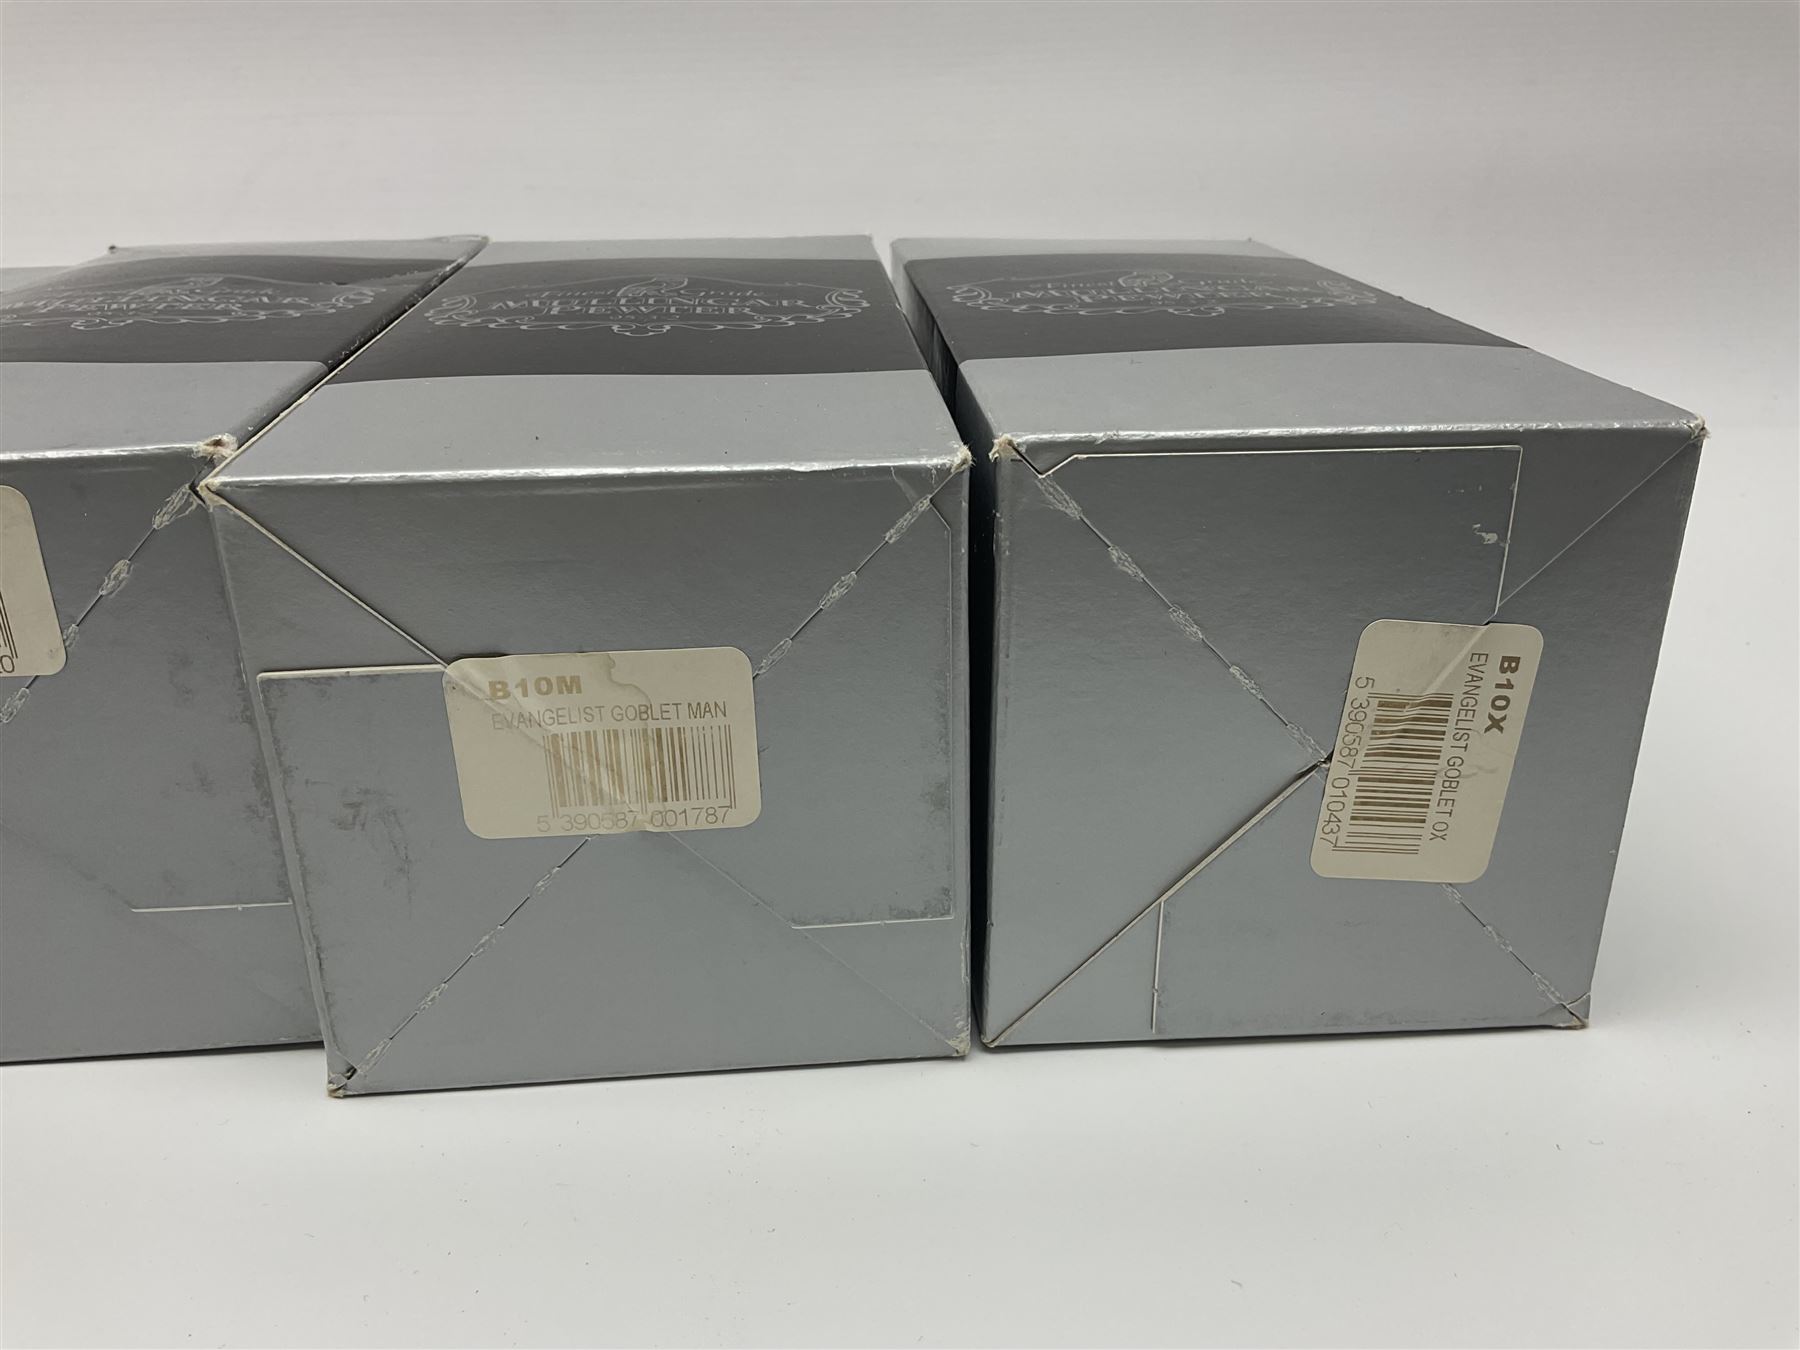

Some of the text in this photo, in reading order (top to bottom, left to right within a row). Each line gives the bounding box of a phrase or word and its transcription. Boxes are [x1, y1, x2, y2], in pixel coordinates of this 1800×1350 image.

[491, 296, 812, 310] MULLINGAR
[541, 305, 757, 315] PEWTER
[488, 675, 583, 700] B10M
[1484, 655, 1521, 734] B10X
[492, 701, 728, 730] EVANGELIST GOBLET MAN
[1429, 653, 1489, 841] EVANGELIST GOBLET OX
[1320, 676, 1375, 847] 5 390587 010437
[537, 805, 730, 832] 5 390587 001787
